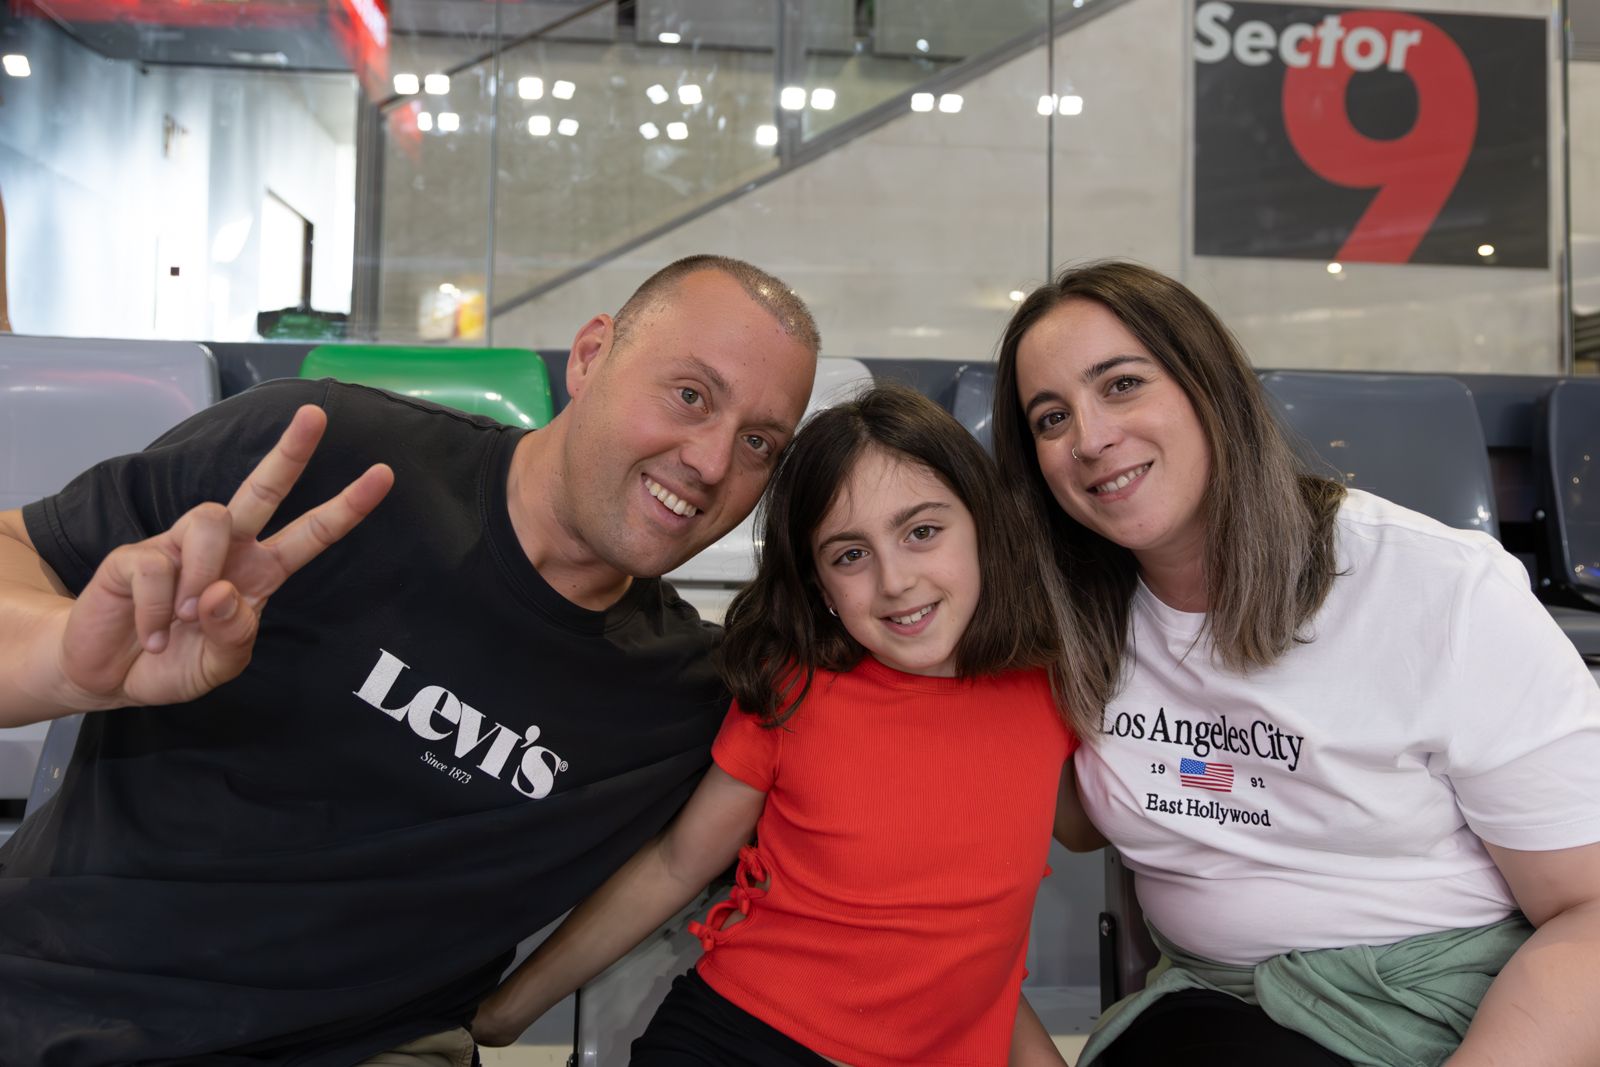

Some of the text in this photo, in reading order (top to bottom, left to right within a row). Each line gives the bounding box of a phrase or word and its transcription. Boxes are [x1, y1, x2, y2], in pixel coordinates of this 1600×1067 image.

[1194, 1, 1422, 71] Sector
[1282, 9, 1479, 265] 9
[1148, 707, 1250, 758] Angeles
[1251, 720, 1304, 771] City
[420, 750, 473, 785] Since 1873
[1150, 763, 1266, 789] 19 92
[1145, 793, 1272, 826] East Hollywood
